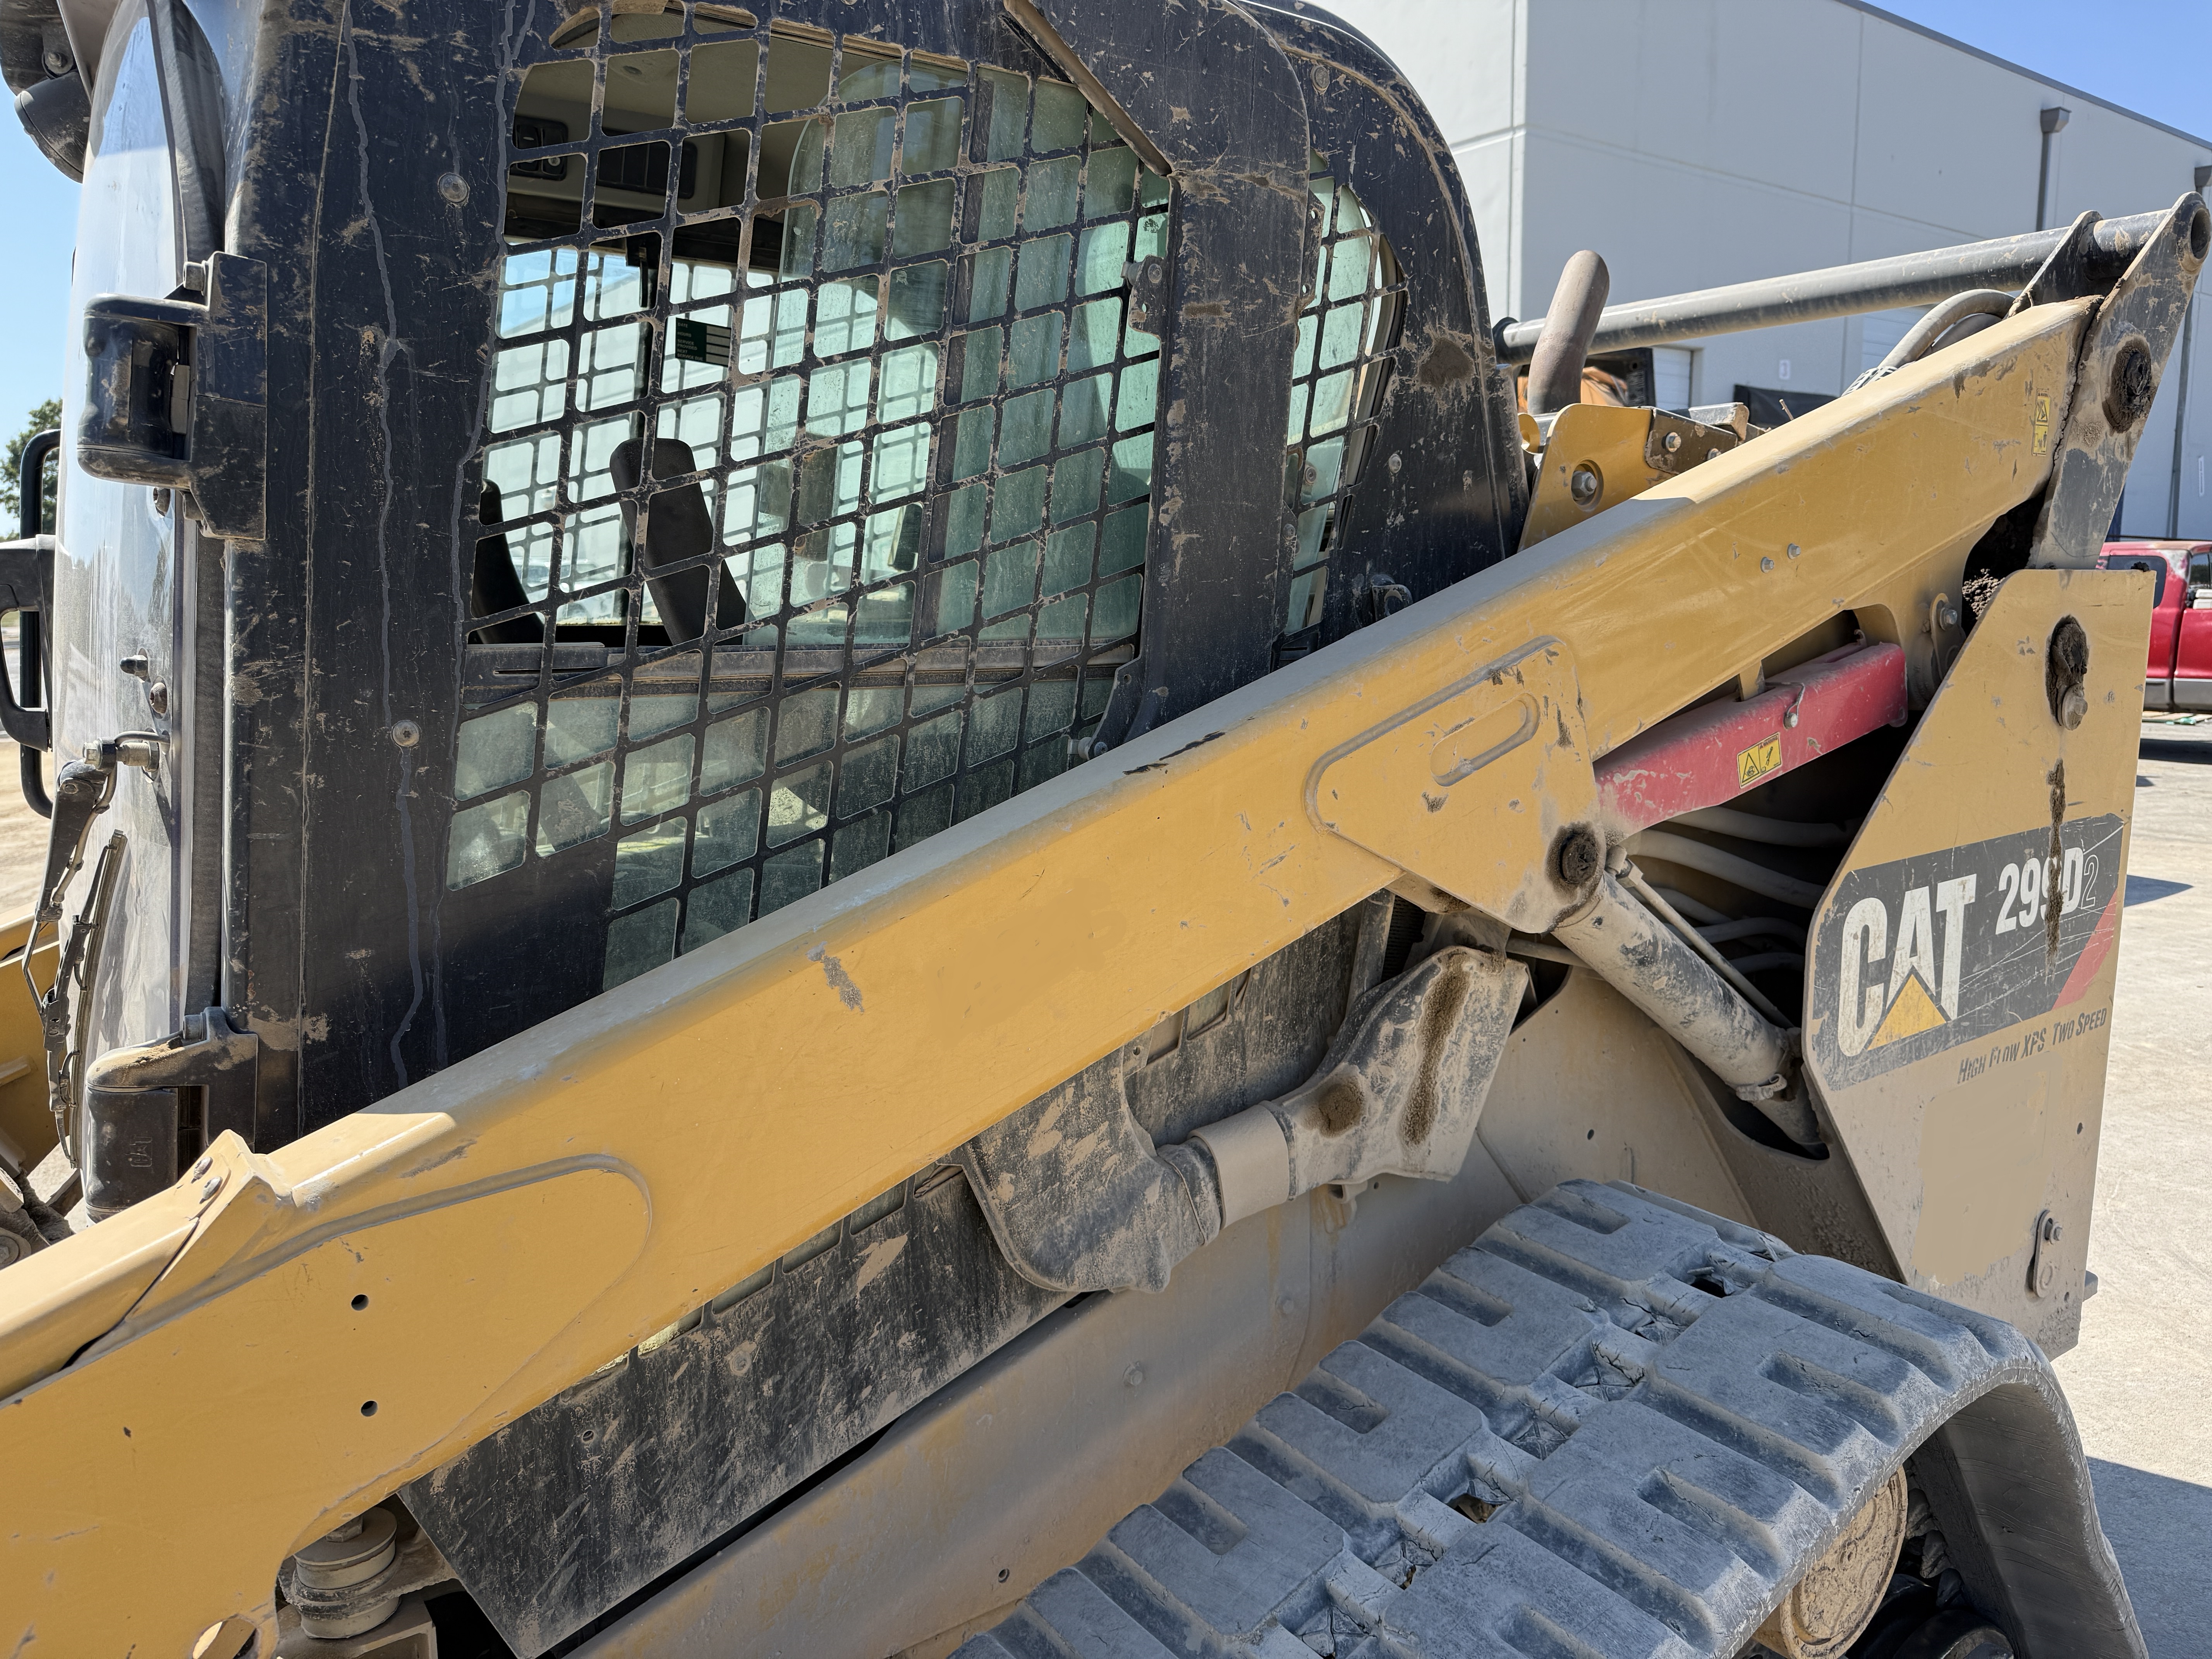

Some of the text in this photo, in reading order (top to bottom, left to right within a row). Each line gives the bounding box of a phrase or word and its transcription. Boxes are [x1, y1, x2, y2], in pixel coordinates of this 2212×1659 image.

[1838, 874, 1977, 1057] CAT
[2021, 1027, 2047, 1059] XPS
[2052, 1020, 2075, 1045] TWO
[2076, 1008, 2107, 1036] SPEED
[130, 1137, 153, 1167] CAT
